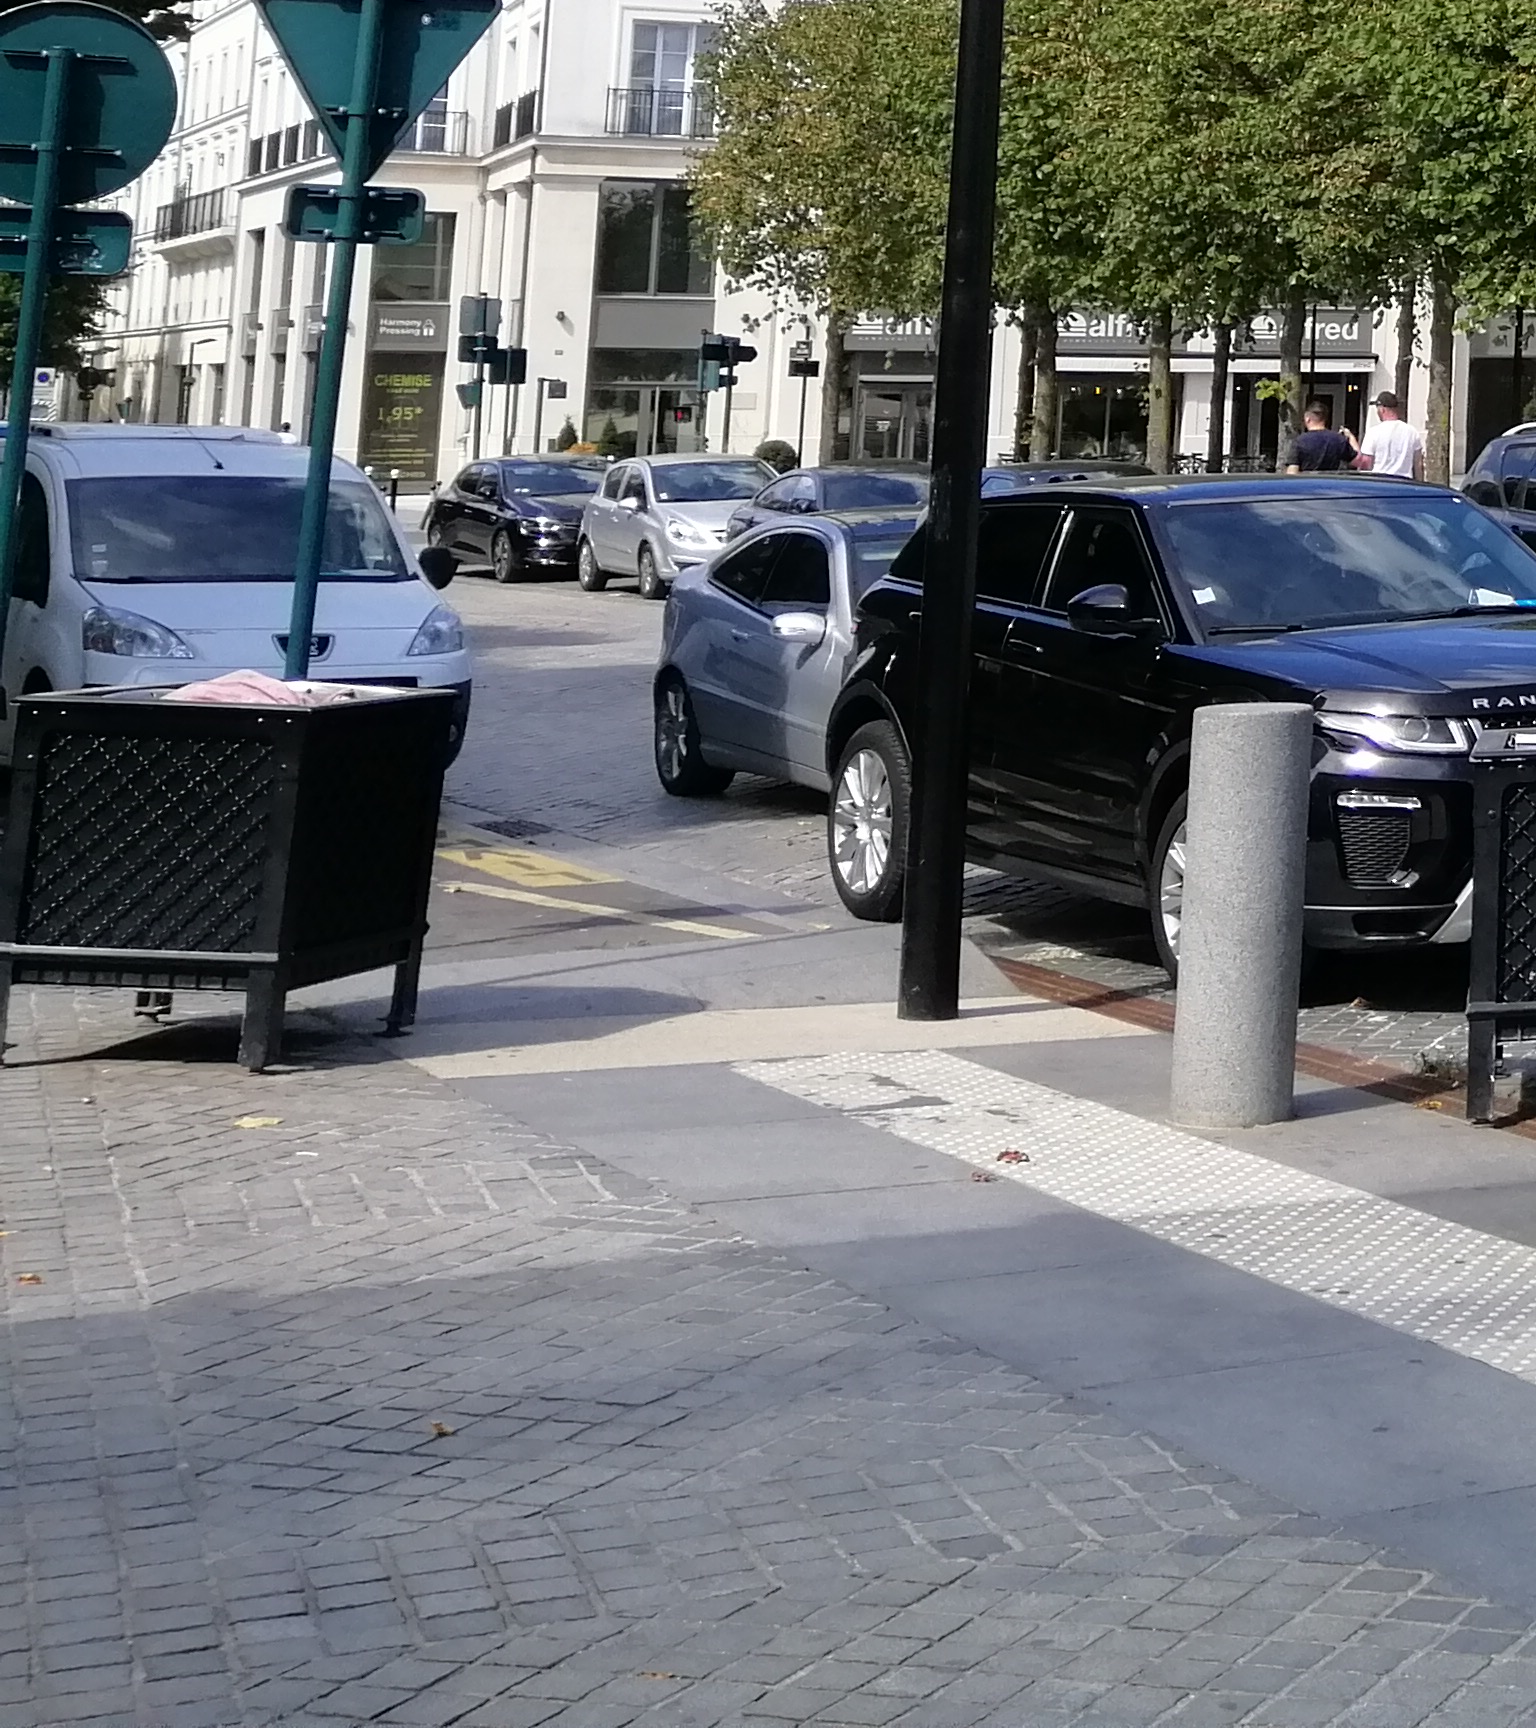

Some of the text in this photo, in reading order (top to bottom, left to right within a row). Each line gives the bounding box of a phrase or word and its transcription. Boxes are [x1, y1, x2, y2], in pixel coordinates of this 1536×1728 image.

[380, 318, 422, 328] Harmony
[380, 326, 421, 337] Pressing
[374, 374, 433, 387] CHEMISE
